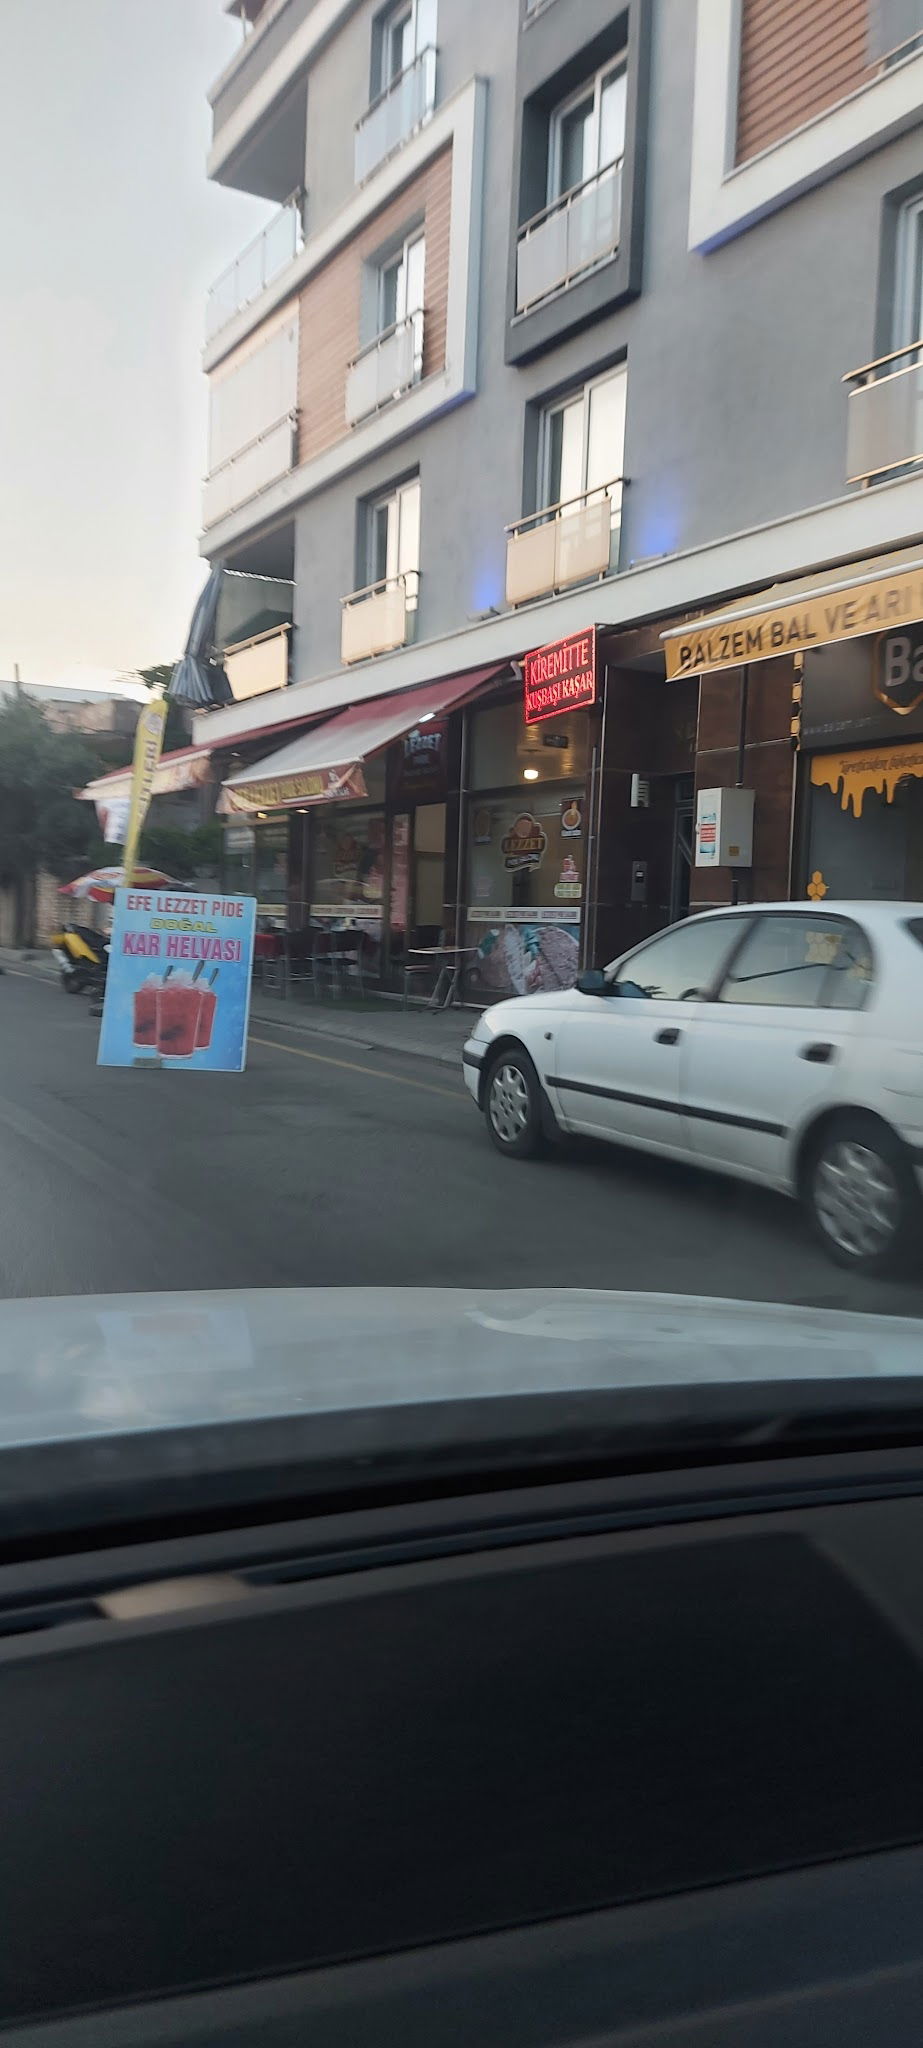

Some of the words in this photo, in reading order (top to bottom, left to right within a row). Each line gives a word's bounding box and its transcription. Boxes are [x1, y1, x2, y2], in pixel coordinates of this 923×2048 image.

[679, 626, 763, 669] BALZEM
[770, 613, 817, 649] BAL
[824, 600, 858, 633] VE
[864, 585, 913, 624] ARI
[530, 637, 589, 686] KİREMİTTE
[526, 682, 562, 711] KUŞBAŞI
[561, 670, 593, 698] KAŞAR
[126, 894, 153, 912] EFE
[157, 897, 208, 915] LEZZET
[211, 898, 244, 917] PİDE
[149, 917, 218, 933] DOĞAL
[122, 932, 161, 957] KAR
[165, 934, 242, 962] HELVASI
